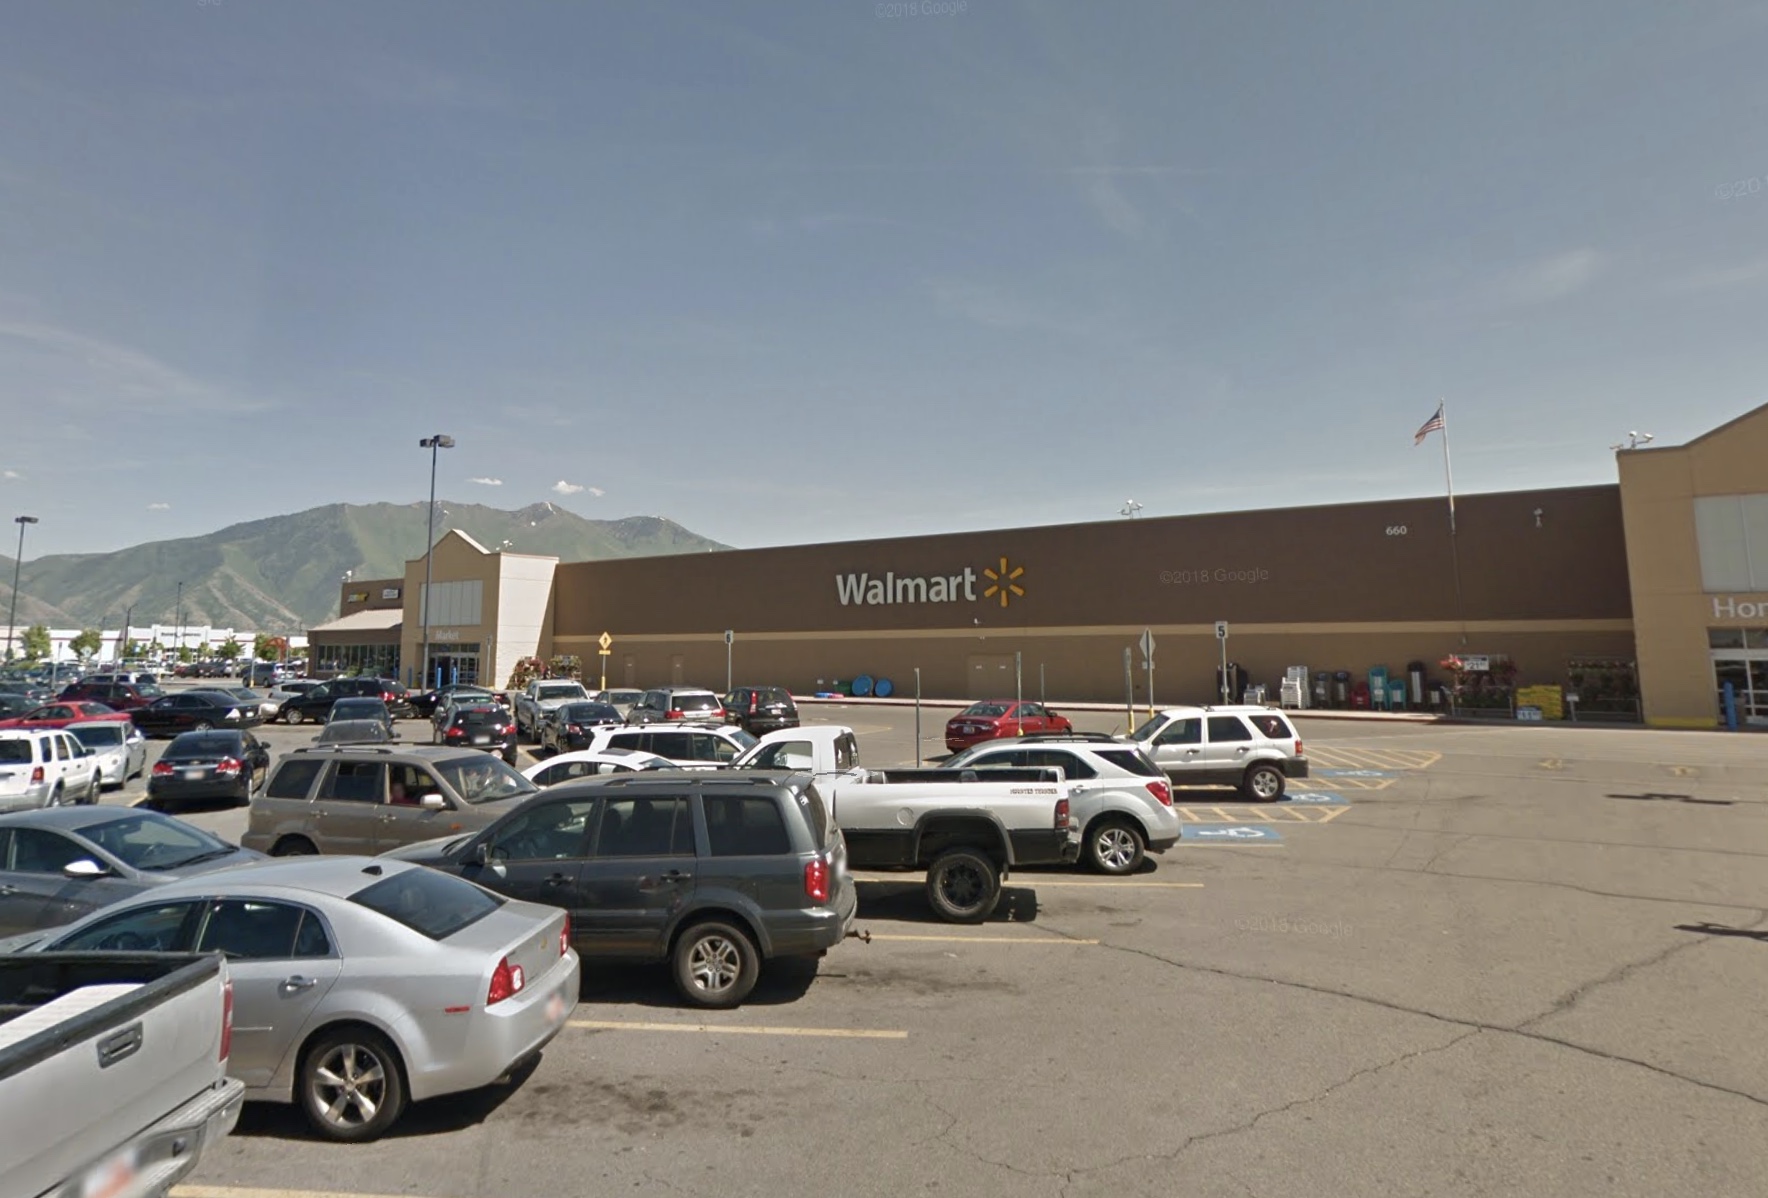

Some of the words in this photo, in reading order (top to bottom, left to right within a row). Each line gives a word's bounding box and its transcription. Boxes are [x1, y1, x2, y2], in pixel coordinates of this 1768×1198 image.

[1386, 525, 1407, 536] 660
[835, 567, 977, 606] Walmart
[1218, 625, 1226, 637] 5
[726, 633, 731, 643] 6
